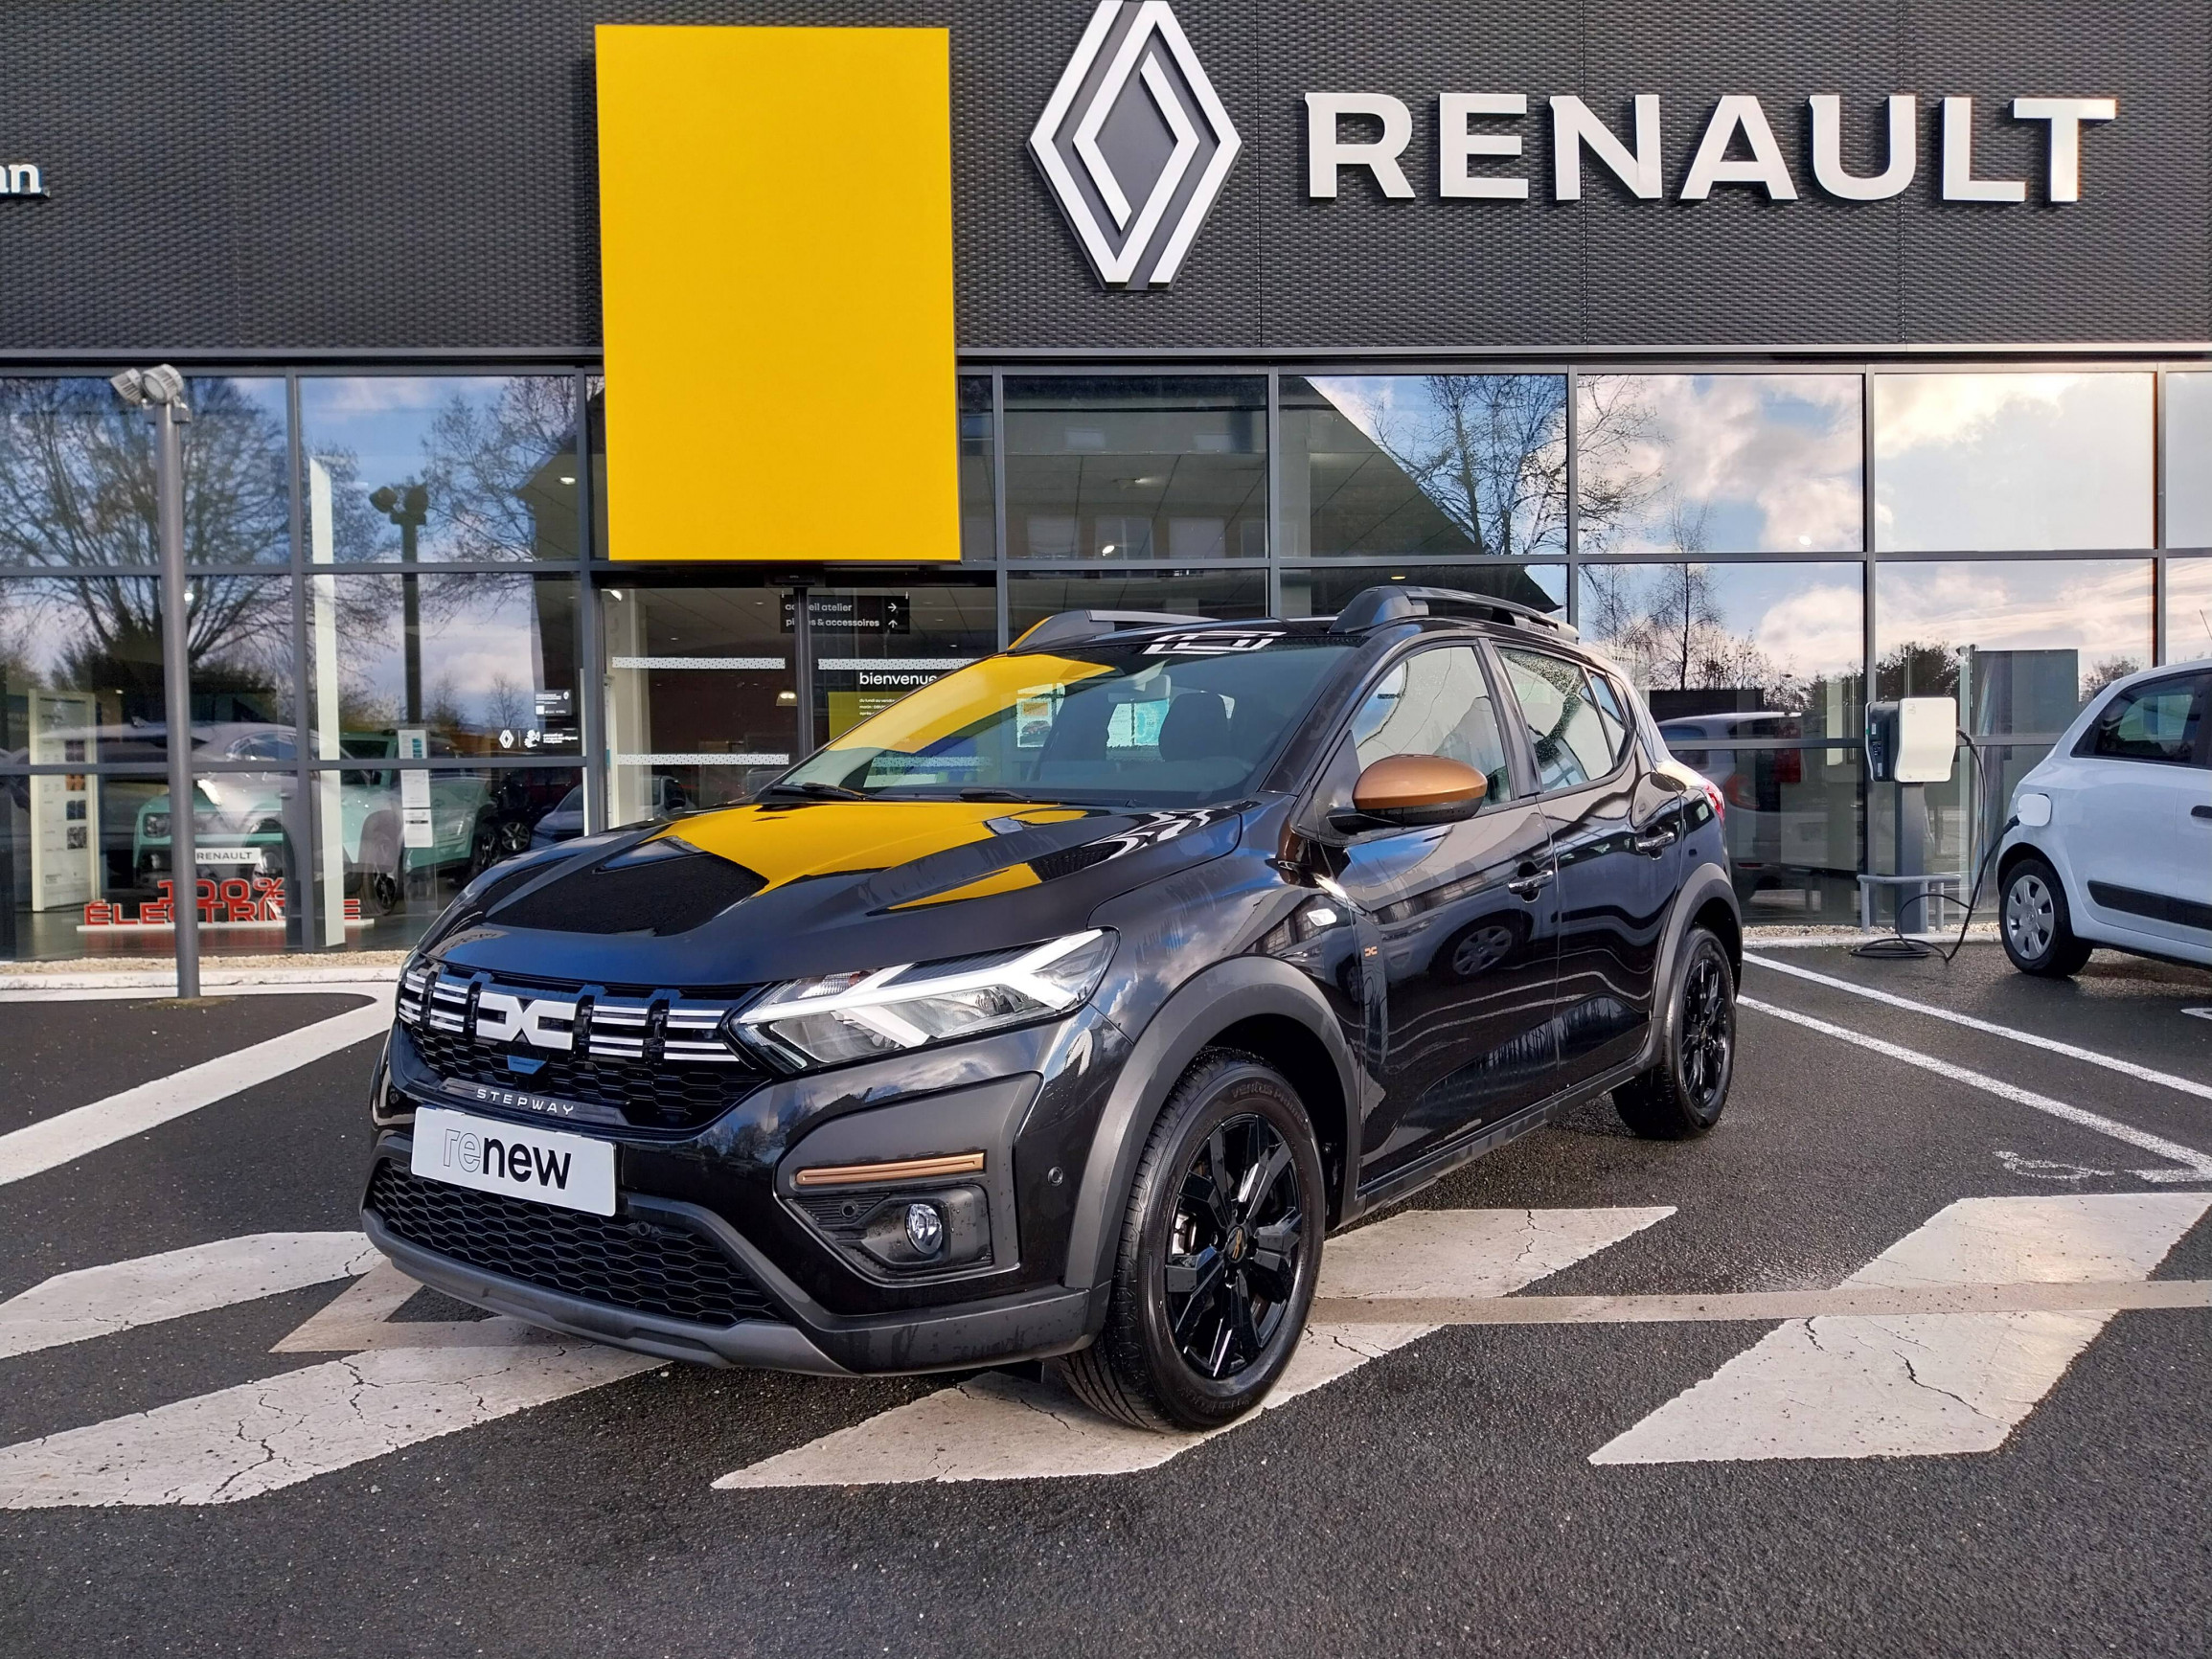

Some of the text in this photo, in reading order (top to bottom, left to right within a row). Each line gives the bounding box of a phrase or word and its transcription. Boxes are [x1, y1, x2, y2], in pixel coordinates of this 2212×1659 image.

[1304, 92, 2116, 203] RENAULT
[0, 164, 41, 193] n
[821, 602, 853, 612] atelier
[817, 618, 824, 626] &
[826, 619, 879, 627] accessoires
[195, 852, 253, 861] RENAULT
[477, 1088, 574, 1115] STEPWAY
[443, 1128, 572, 1191] renew
